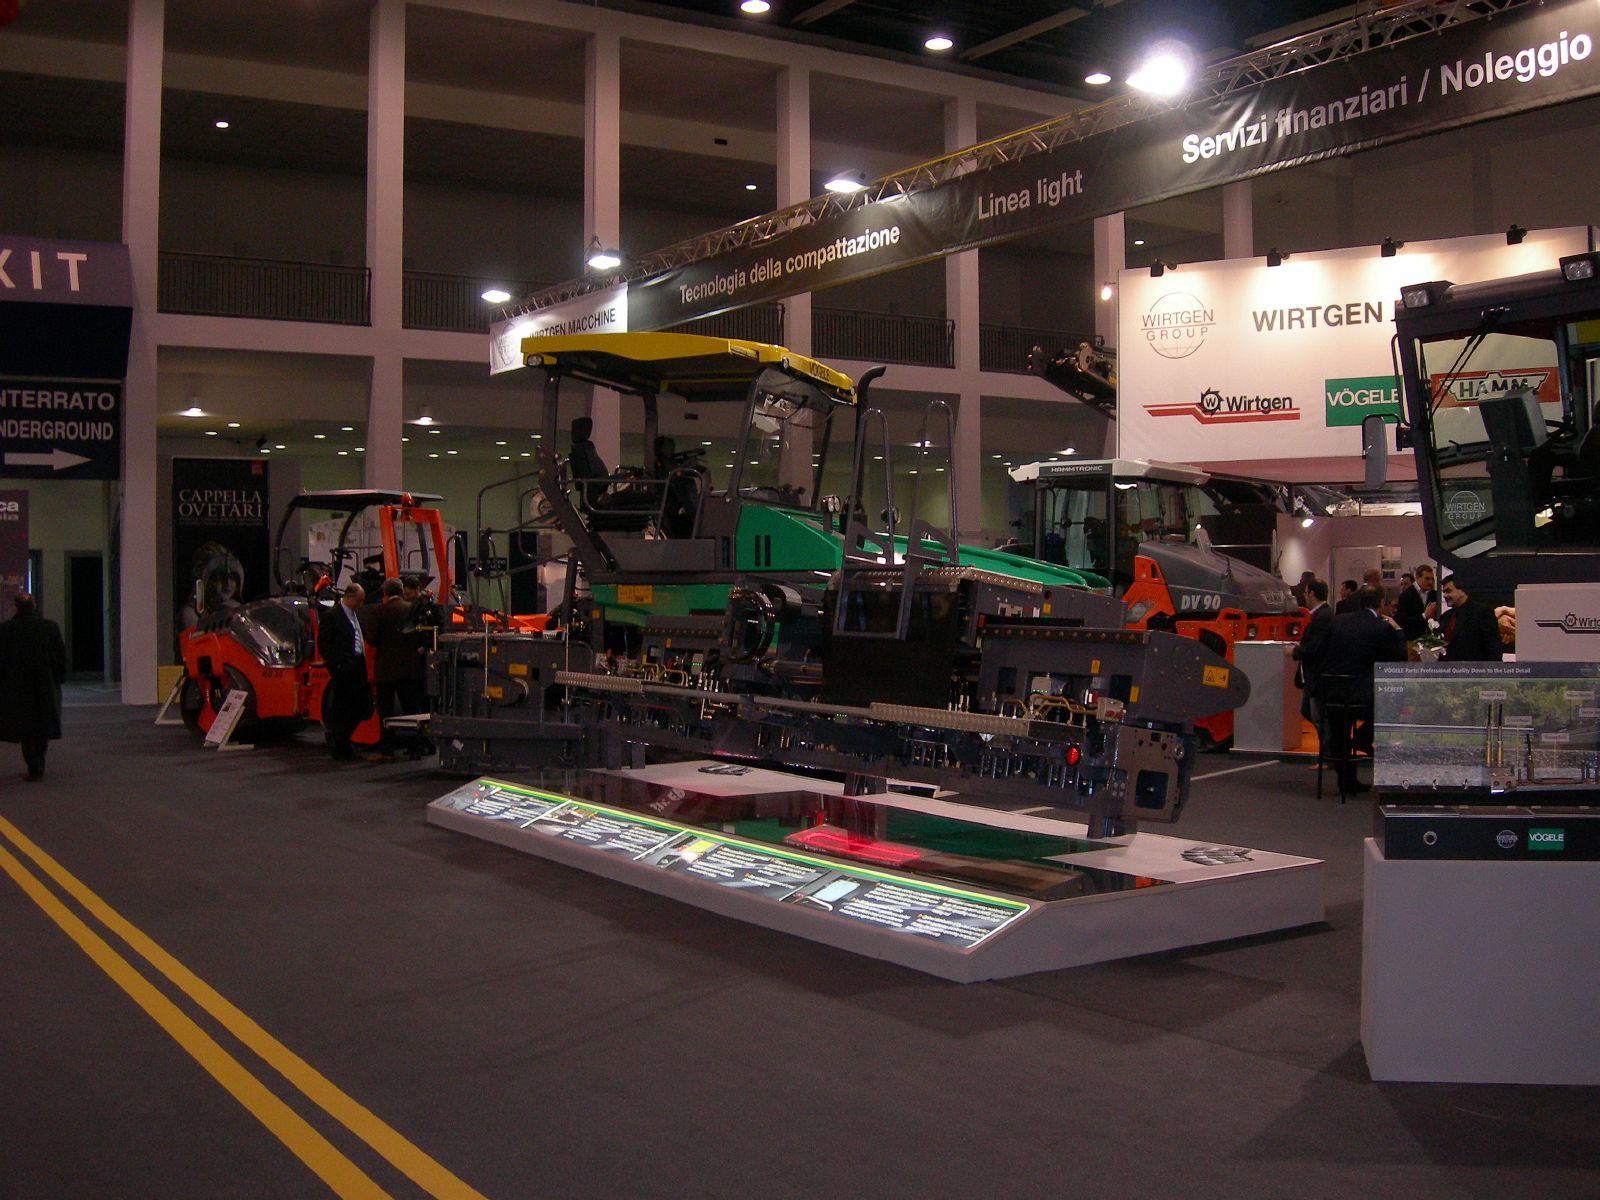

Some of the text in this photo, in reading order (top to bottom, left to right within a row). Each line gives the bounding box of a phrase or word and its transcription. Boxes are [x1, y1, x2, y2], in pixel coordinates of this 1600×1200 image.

[1182, 31, 1592, 164] Servizi finanziari / Noleggio
[978, 169, 1083, 220] Linea light
[679, 226, 901, 304] Tecnologia della compattazione
[568, 308, 616, 335] MACCHINE
[1142, 309, 1214, 328] WIRTGEN
[1252, 301, 1383, 332] WIRTGEN
[1146, 327, 1209, 341] GROUP
[1459, 378, 1529, 398] HAMM
[1226, 395, 1293, 414] Wirtgen
[1327, 388, 1399, 408] VÖGELE
[1051, 465, 1103, 473] HAMMTRONIC
[179, 489, 262, 503] CAPPELLA
[178, 503, 262, 517] OVETARI
[1445, 502, 1485, 511] WIRTGEN
[1447, 512, 1482, 520] GROUP
[1181, 594, 1221, 610] DV 90
[1529, 832, 1565, 842] VÖGELE
